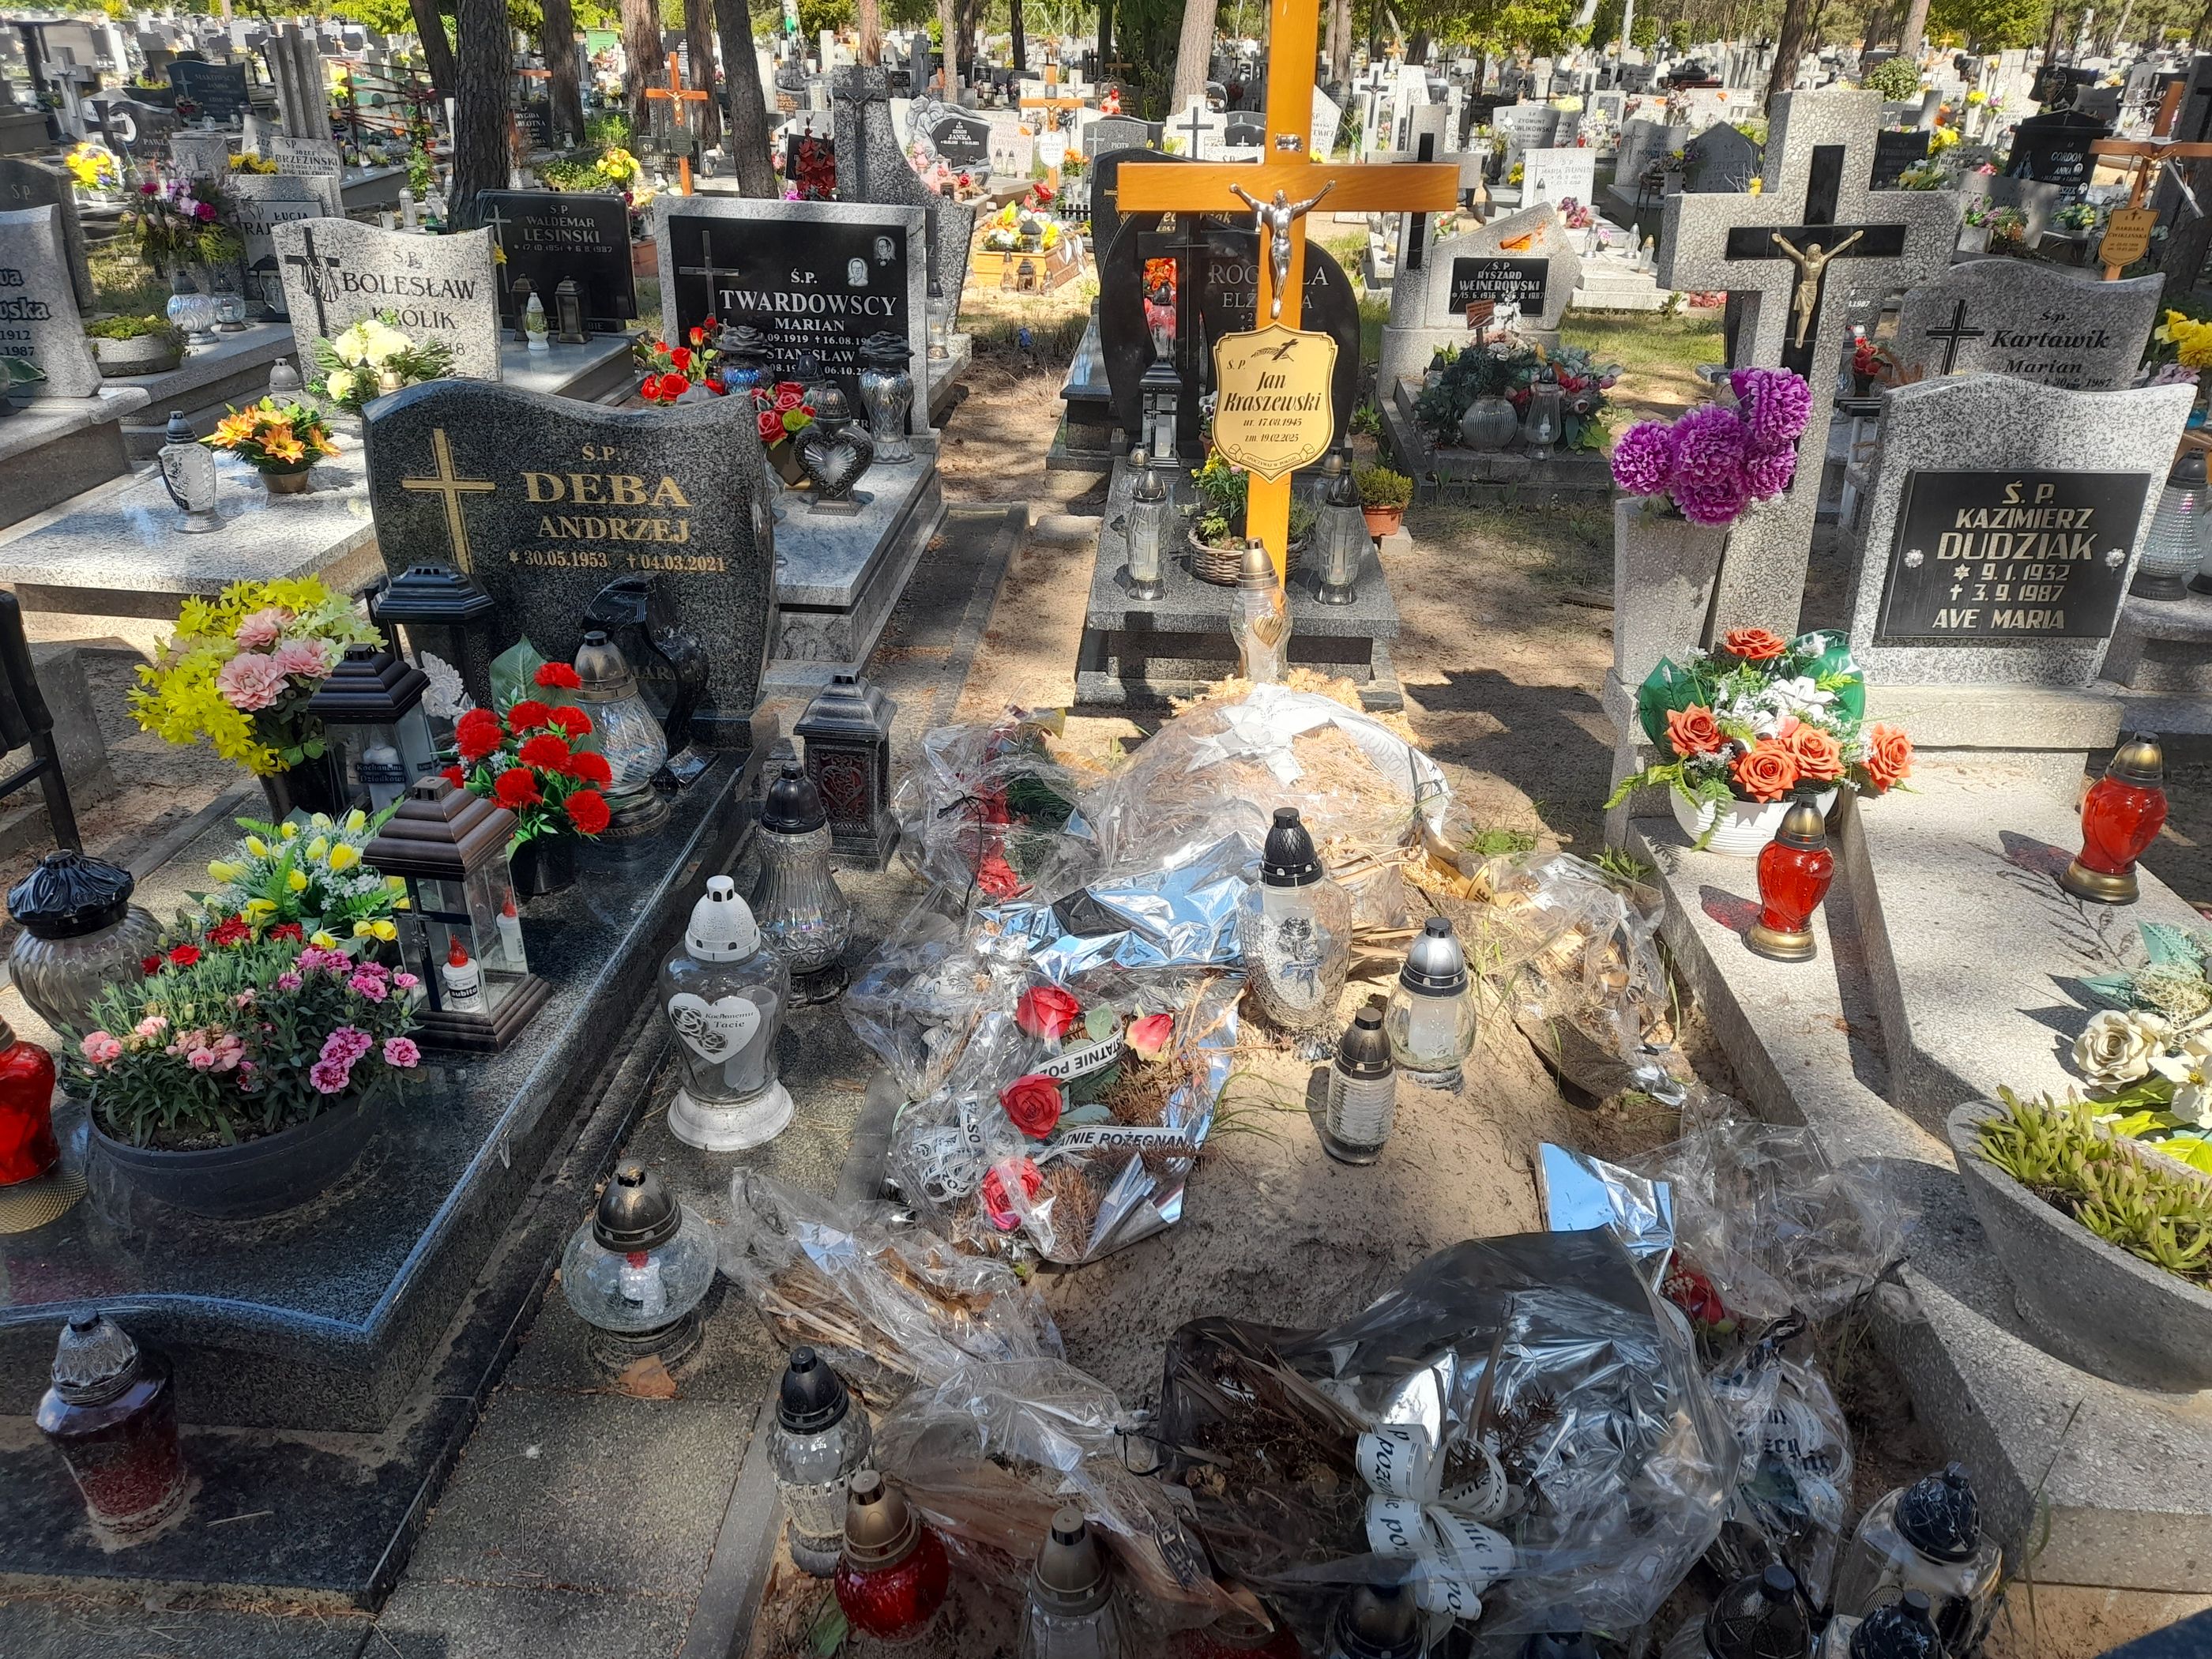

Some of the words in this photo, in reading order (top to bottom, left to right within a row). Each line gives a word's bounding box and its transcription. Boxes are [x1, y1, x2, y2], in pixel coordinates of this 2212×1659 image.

[2051, 152, 2084, 162] GORDON
[525, 216, 596, 228] WALDEMAR
[1459, 280, 1540, 291] WEINEROWSKI
[1477, 271, 1522, 280] RYSZARD
[342, 273, 476, 299] BOLESŁAW
[719, 289, 897, 316] TWARDOWSCY
[774, 318, 845, 332] MARIAN
[1990, 329, 2111, 348] Kartawik
[2003, 359, 2082, 374] Marian
[1256, 371, 1287, 392] Jan
[1224, 392, 1322, 412] Kraszewski
[1258, 418, 1303, 427] 17.08.1945
[520, 472, 693, 508] DEBA
[1954, 508, 2095, 529] KAZIMIERZ
[536, 517, 692, 544] ANDRZEJ
[1936, 532, 2099, 560] DUDZIAK
[524, 551, 609, 568] 30.05.1953
[640, 554, 727, 573] 04.03.2021
[1932, 608, 1981, 629] AVE
[1990, 609, 2065, 629] MARIA
[451, 986, 477, 997] subito
